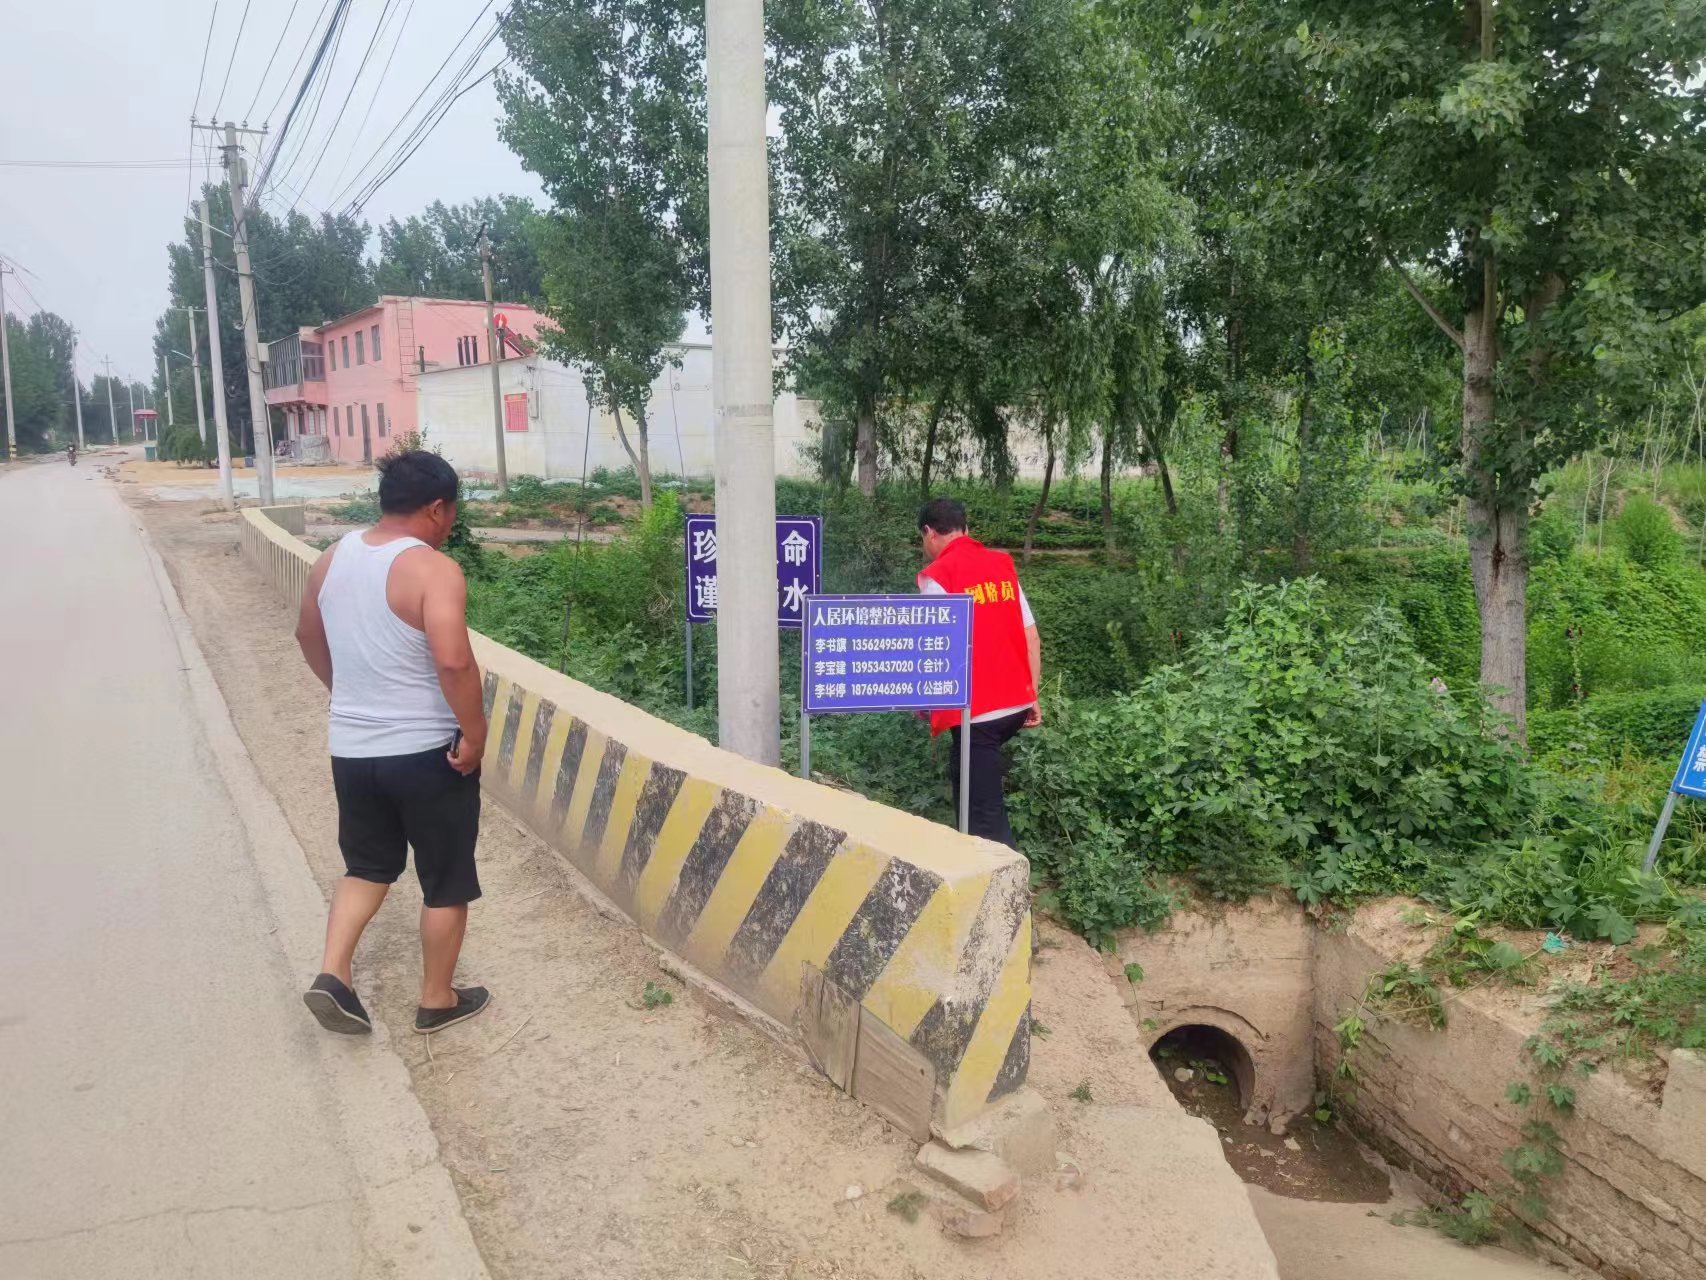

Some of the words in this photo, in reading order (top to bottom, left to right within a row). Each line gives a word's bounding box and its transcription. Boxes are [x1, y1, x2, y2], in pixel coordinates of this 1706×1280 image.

[693, 529, 810, 566] 珍命
[695, 575, 809, 612] 谨水
[964, 581, 1015, 604] 网格员
[813, 606, 957, 626] 人居环境整治责任片区：
